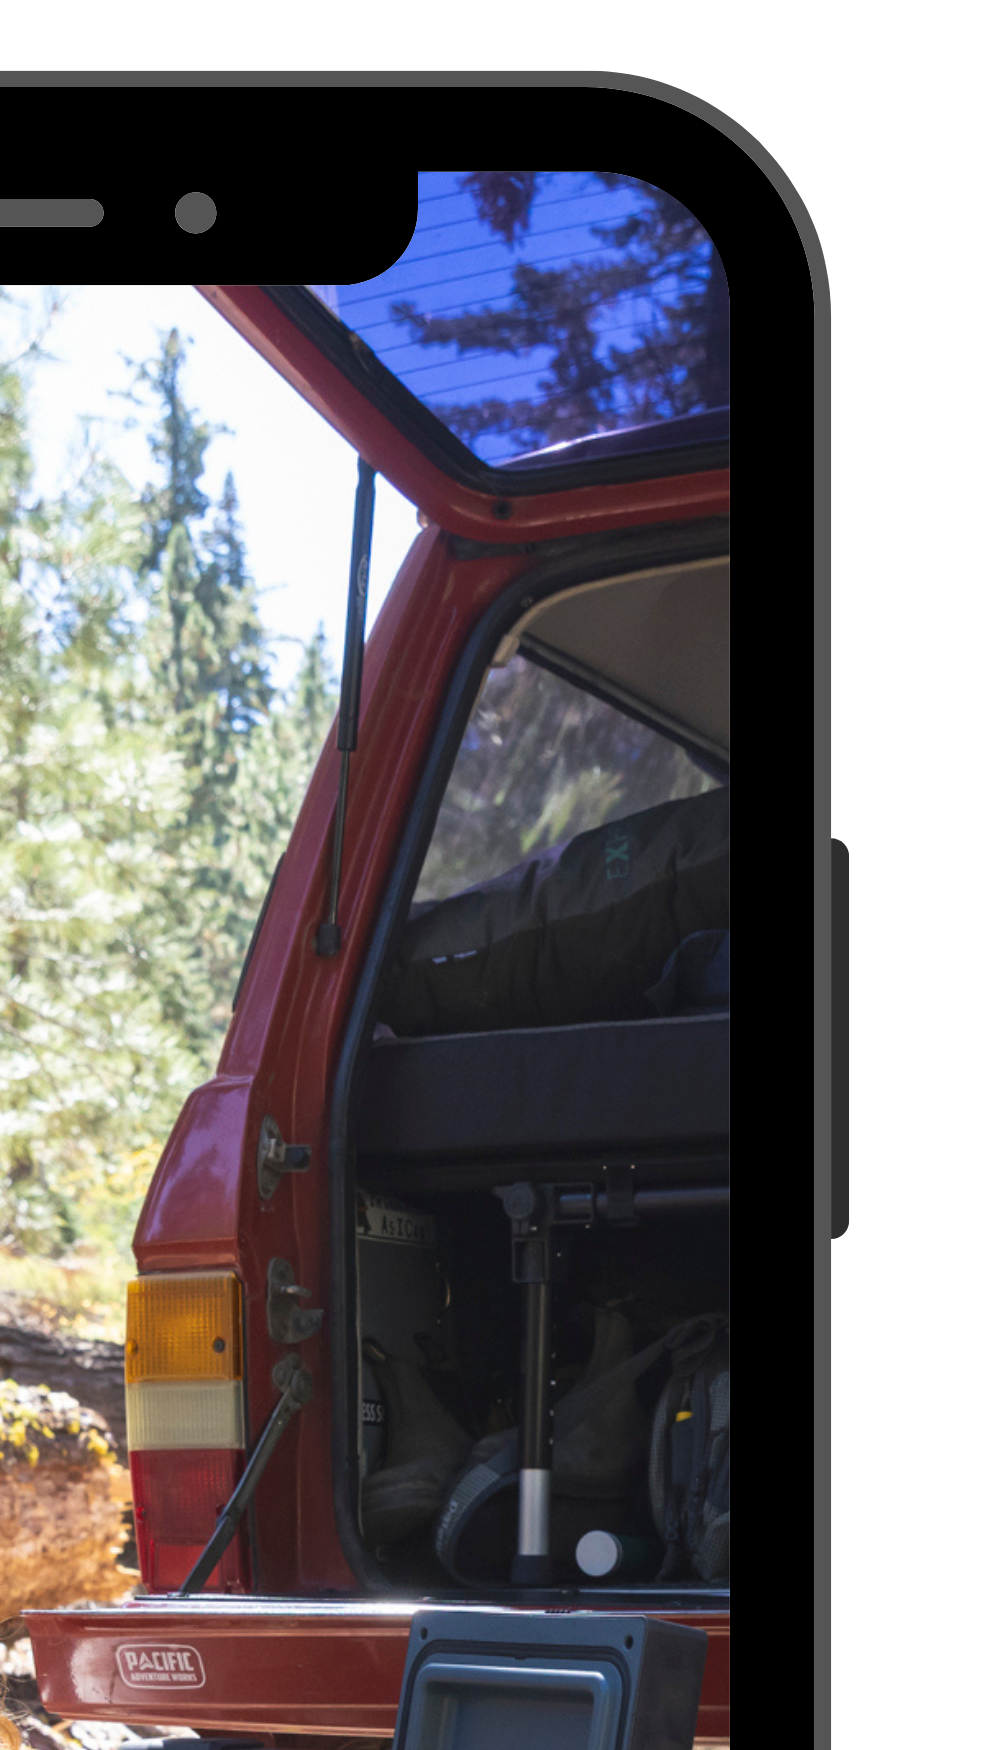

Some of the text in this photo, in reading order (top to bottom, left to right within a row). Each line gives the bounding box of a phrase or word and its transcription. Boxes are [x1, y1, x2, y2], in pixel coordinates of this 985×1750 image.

[124, 1651, 194, 1672] PACIFIC
[130, 1672, 197, 1682] ADVENTURE WORKS
